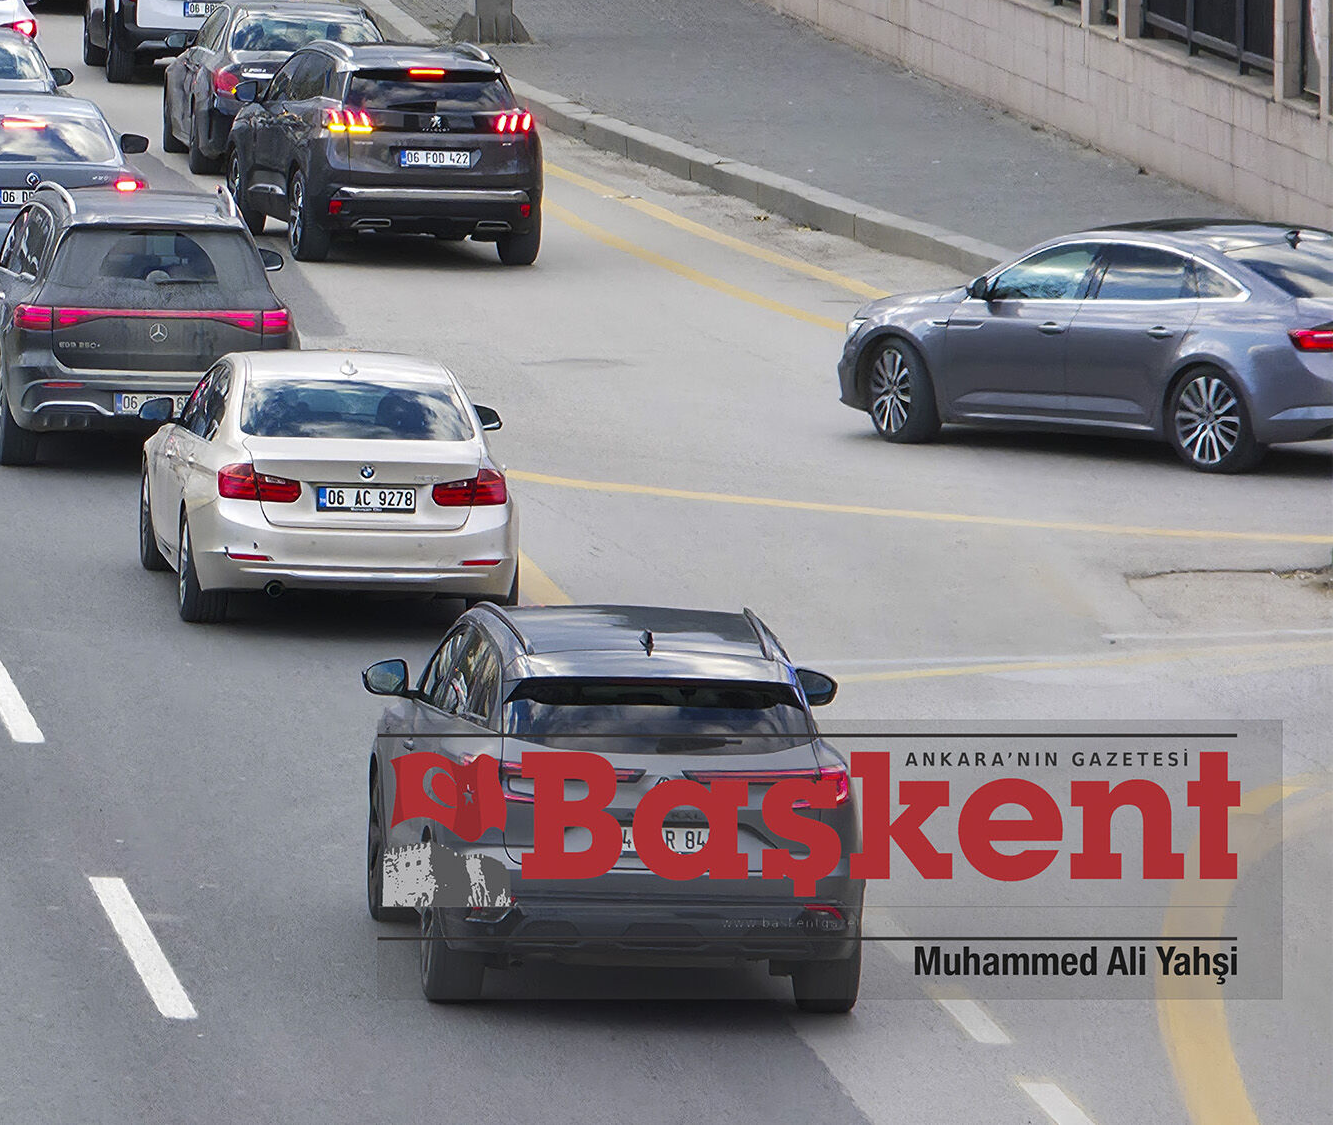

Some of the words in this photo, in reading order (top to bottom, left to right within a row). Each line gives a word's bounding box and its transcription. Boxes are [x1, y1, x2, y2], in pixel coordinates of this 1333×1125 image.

[407, 152, 420, 163] 06
[449, 153, 469, 165] 422
[2, 190, 15, 203] 06
[123, 396, 138, 409] 06
[328, 490, 345, 506] 06
[354, 491, 372, 507] AC
[379, 491, 413, 508] 9278
